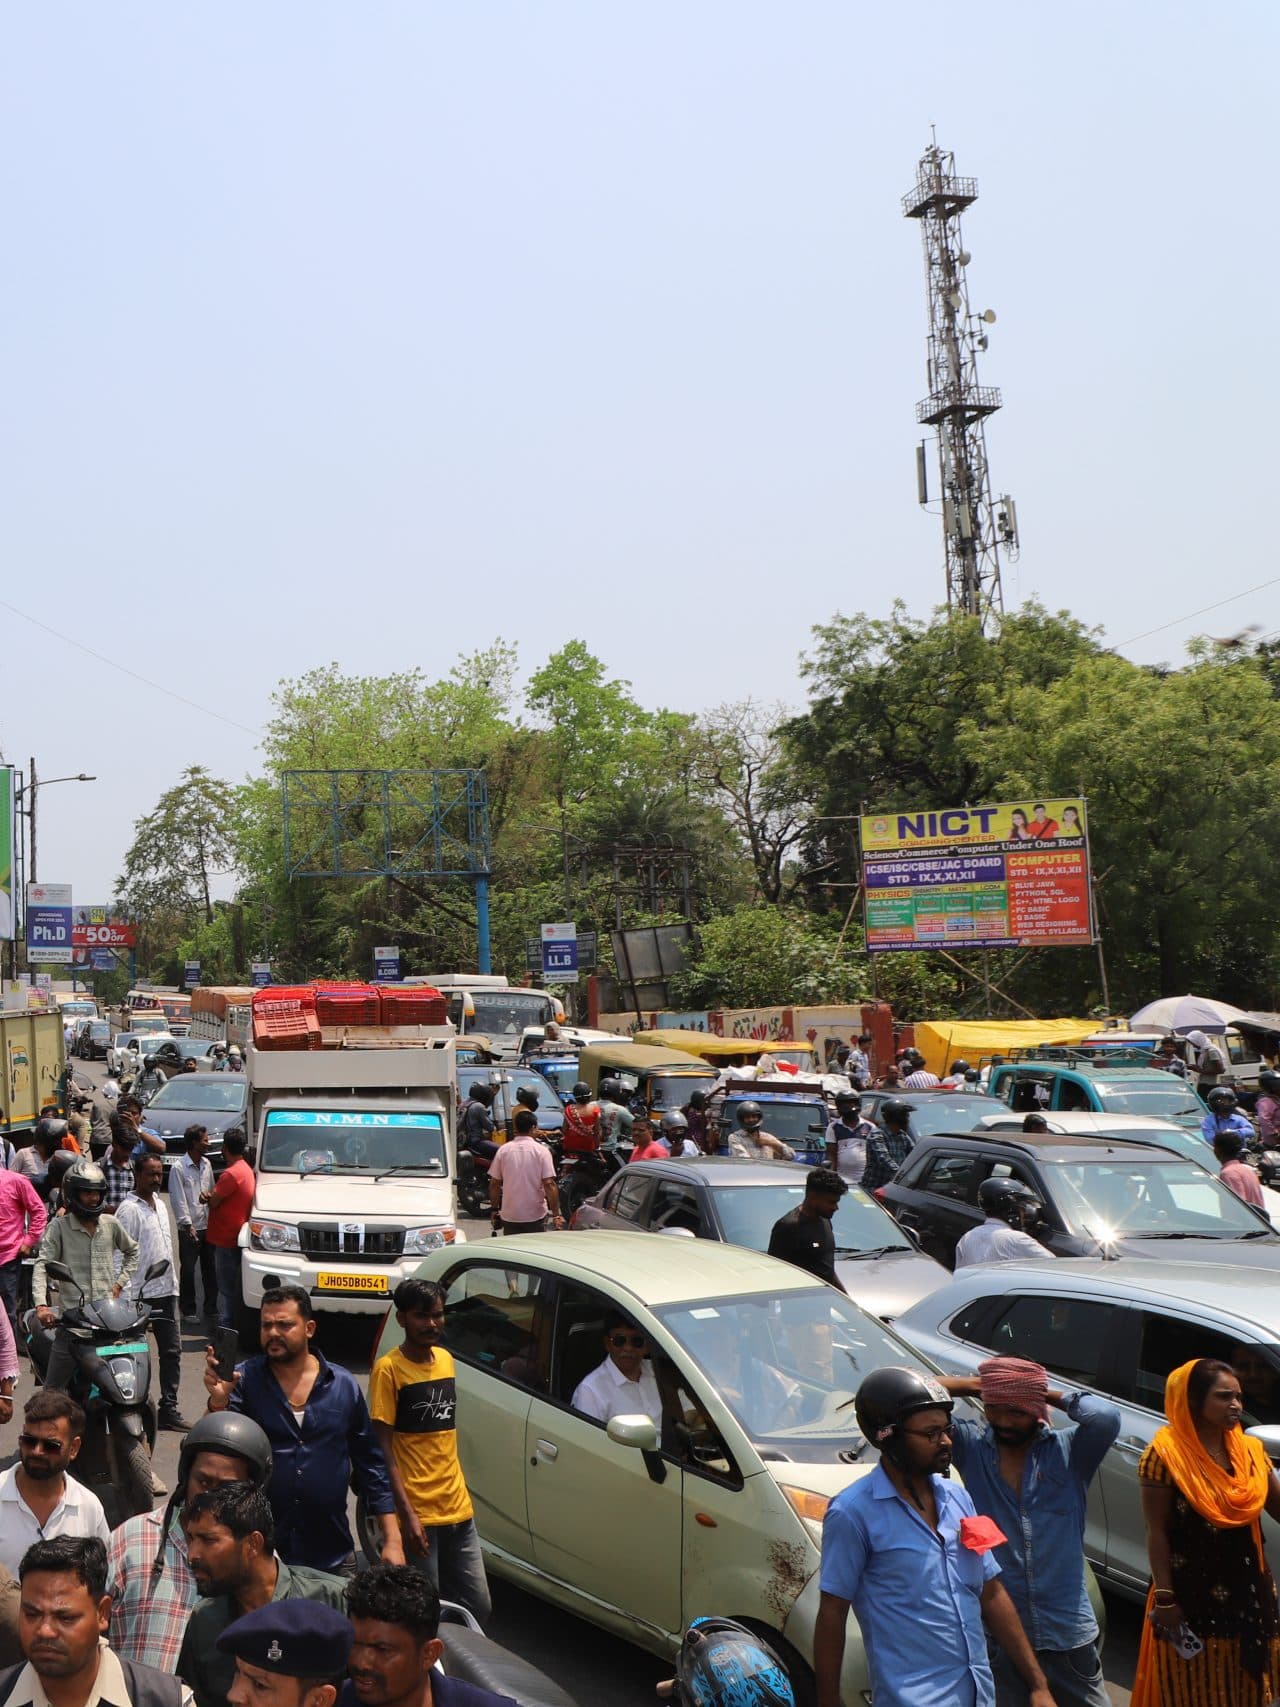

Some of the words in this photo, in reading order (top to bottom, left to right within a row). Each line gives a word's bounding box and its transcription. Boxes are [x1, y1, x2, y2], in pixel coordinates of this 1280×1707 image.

[897, 807, 998, 839] NICT
[1001, 840, 1032, 850] Under
[1034, 838, 1056, 848] One
[1057, 837, 1082, 846] Roof
[867, 858, 960, 874] ICSE/ISC/CBSE/JAC
[963, 856, 1001, 868] BOARD
[1008, 853, 1080, 866] COMPUTER
[1010, 868, 1027, 876] STD
[887, 874, 909, 883] STD
[1014, 881, 1034, 889] BLUE
[866, 889, 910, 899] PHYSICS
[33, 926, 66, 940] Ph.D
[548, 955, 571, 966] LL.B
[474, 997, 546, 1007] SUBHAM
[315, 1114, 390, 1125] N.M.N
[324, 1276, 385, 1288] JH05DB0541
